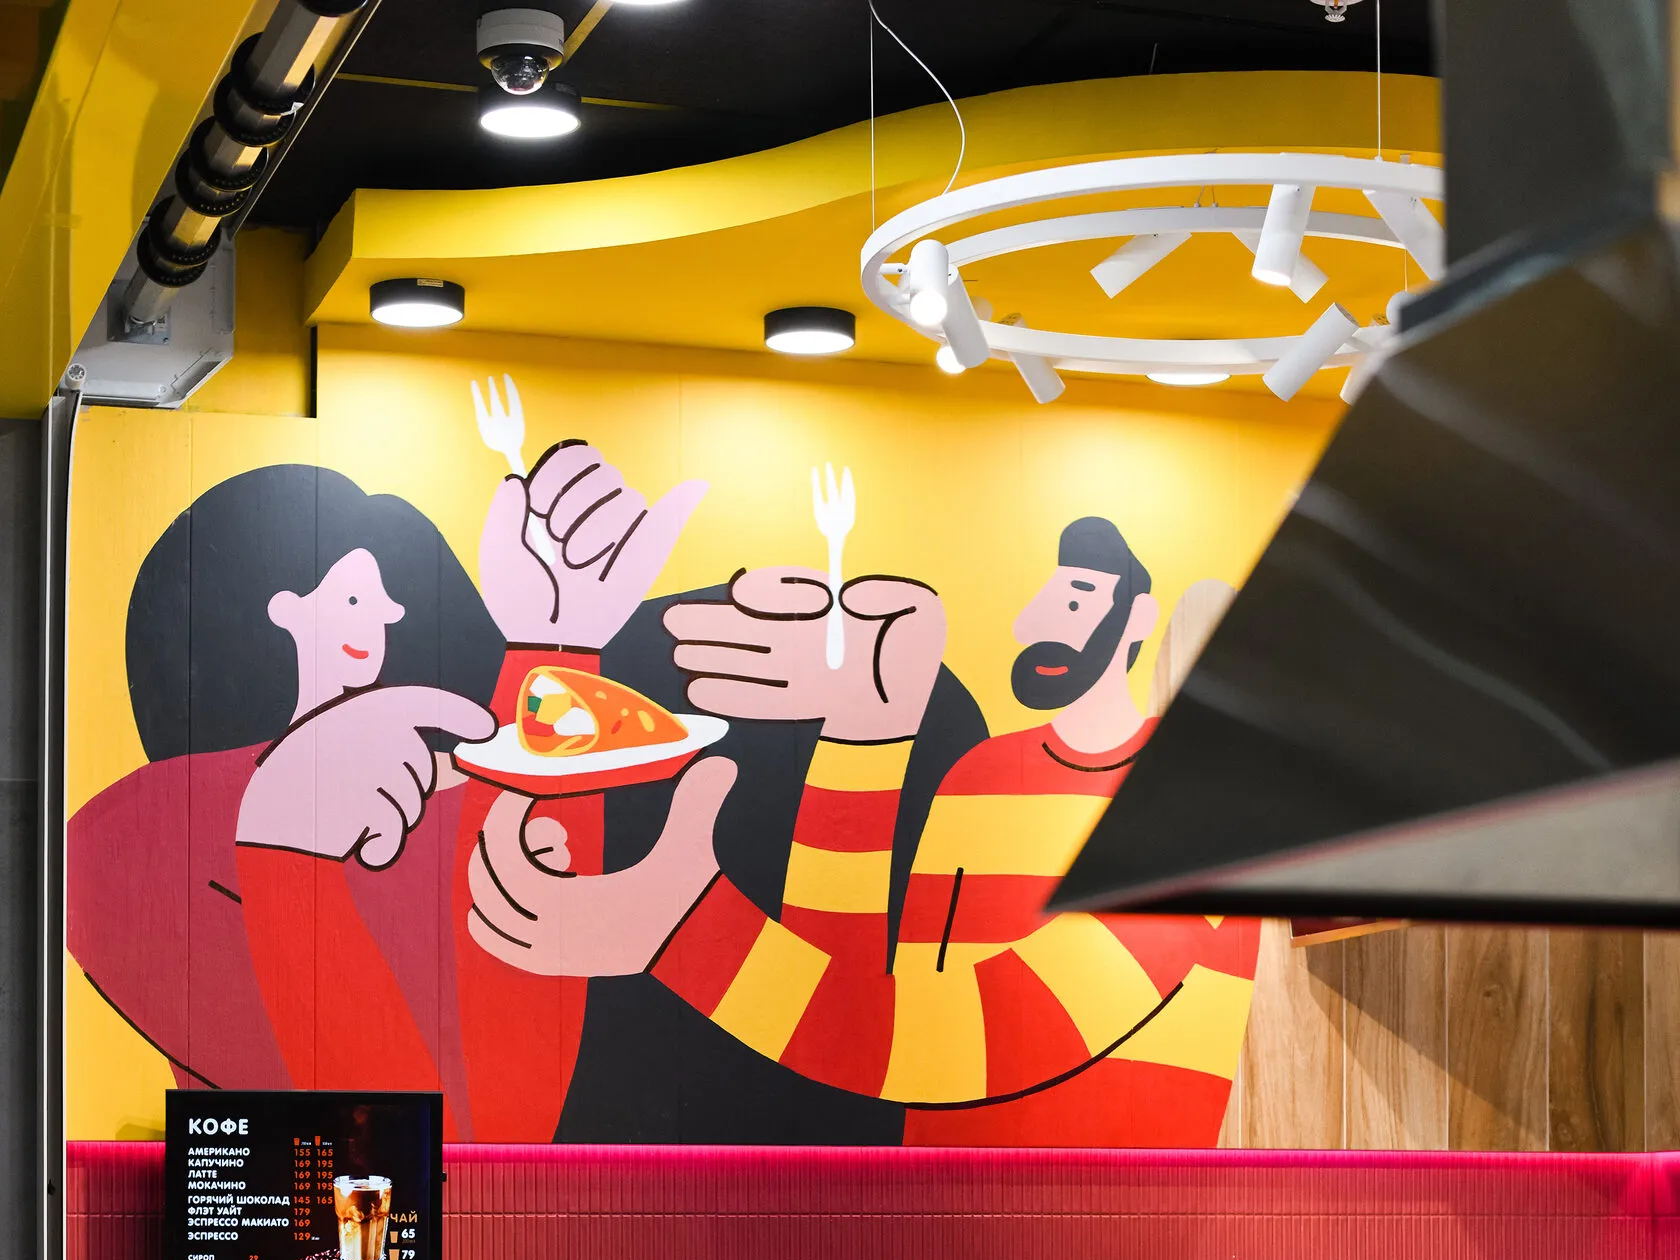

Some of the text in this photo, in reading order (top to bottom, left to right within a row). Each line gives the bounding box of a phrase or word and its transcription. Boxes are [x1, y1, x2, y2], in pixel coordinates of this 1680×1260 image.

[189, 1118, 248, 1135] КОФЕ
[188, 1148, 250, 1156] АМЕРИКАНО
[317, 1149, 333, 1157] 165
[188, 1159, 243, 1167] КАПУЧИНО
[317, 1160, 333, 1168] 195
[188, 1170, 217, 1178] ЛАТТЕ
[294, 1171, 333, 1179] 169 195
[188, 1182, 245, 1190] МОКАЧИНО
[294, 1182, 333, 1190] 169 195
[188, 1194, 290, 1205] ГОРЯЧИЙ ШОКОЛАД
[294, 1196, 333, 1204] 145 165
[188, 1206, 242, 1215] ФЛЭТ УАЙТ
[390, 1211, 417, 1223] ЧАЙ
[188, 1218, 289, 1227] ЭСПРЕССО МАКИАТО
[294, 1219, 310, 1227] 169
[188, 1232, 238, 1240] ЭСПРЕССО
[402, 1229, 415, 1239] 65
[402, 1250, 415, 1260] 79
